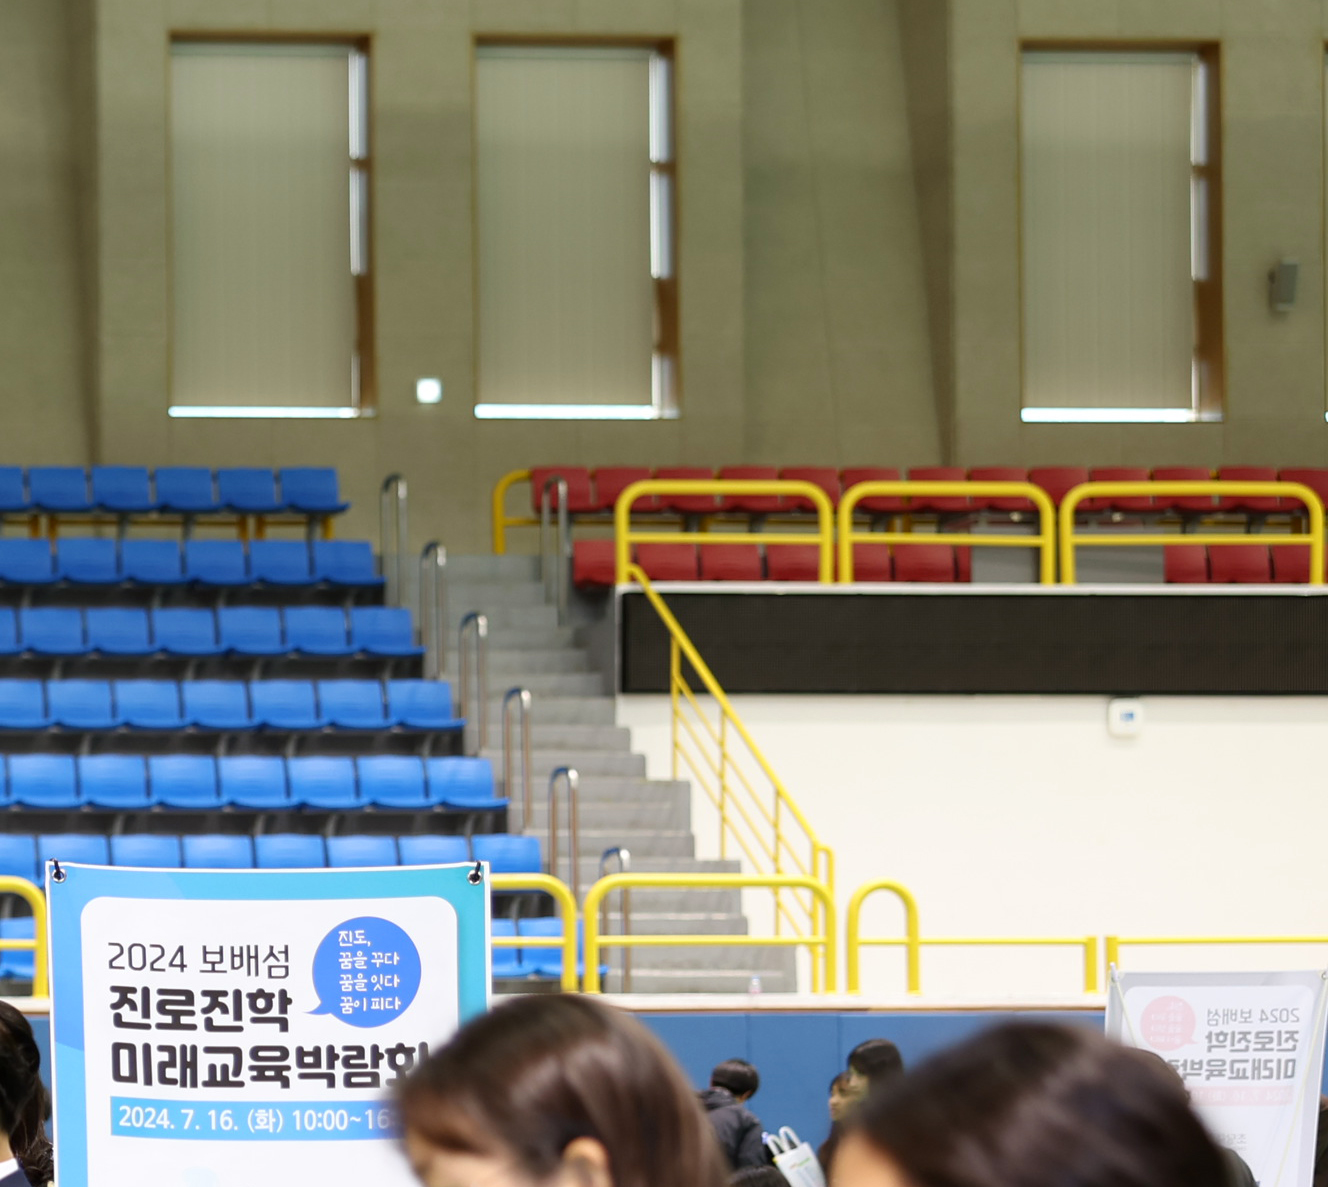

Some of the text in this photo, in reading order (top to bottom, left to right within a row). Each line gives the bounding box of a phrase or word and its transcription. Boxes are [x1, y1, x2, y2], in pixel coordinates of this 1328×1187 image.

[337, 929, 371, 947] 진도,
[108, 942, 290, 979] 2024 보배섬
[338, 951, 400, 969] 꿈을 꾸다
[338, 973, 368, 992] 꿈을
[109, 985, 293, 1032] 진로진학
[339, 996, 401, 1014] 꿈이 피다
[119, 1105, 175, 1129] 2024.
[181, 1109, 200, 1130] 7.
[208, 1110, 239, 1131] 16.
[247, 1108, 284, 1133] (화)
